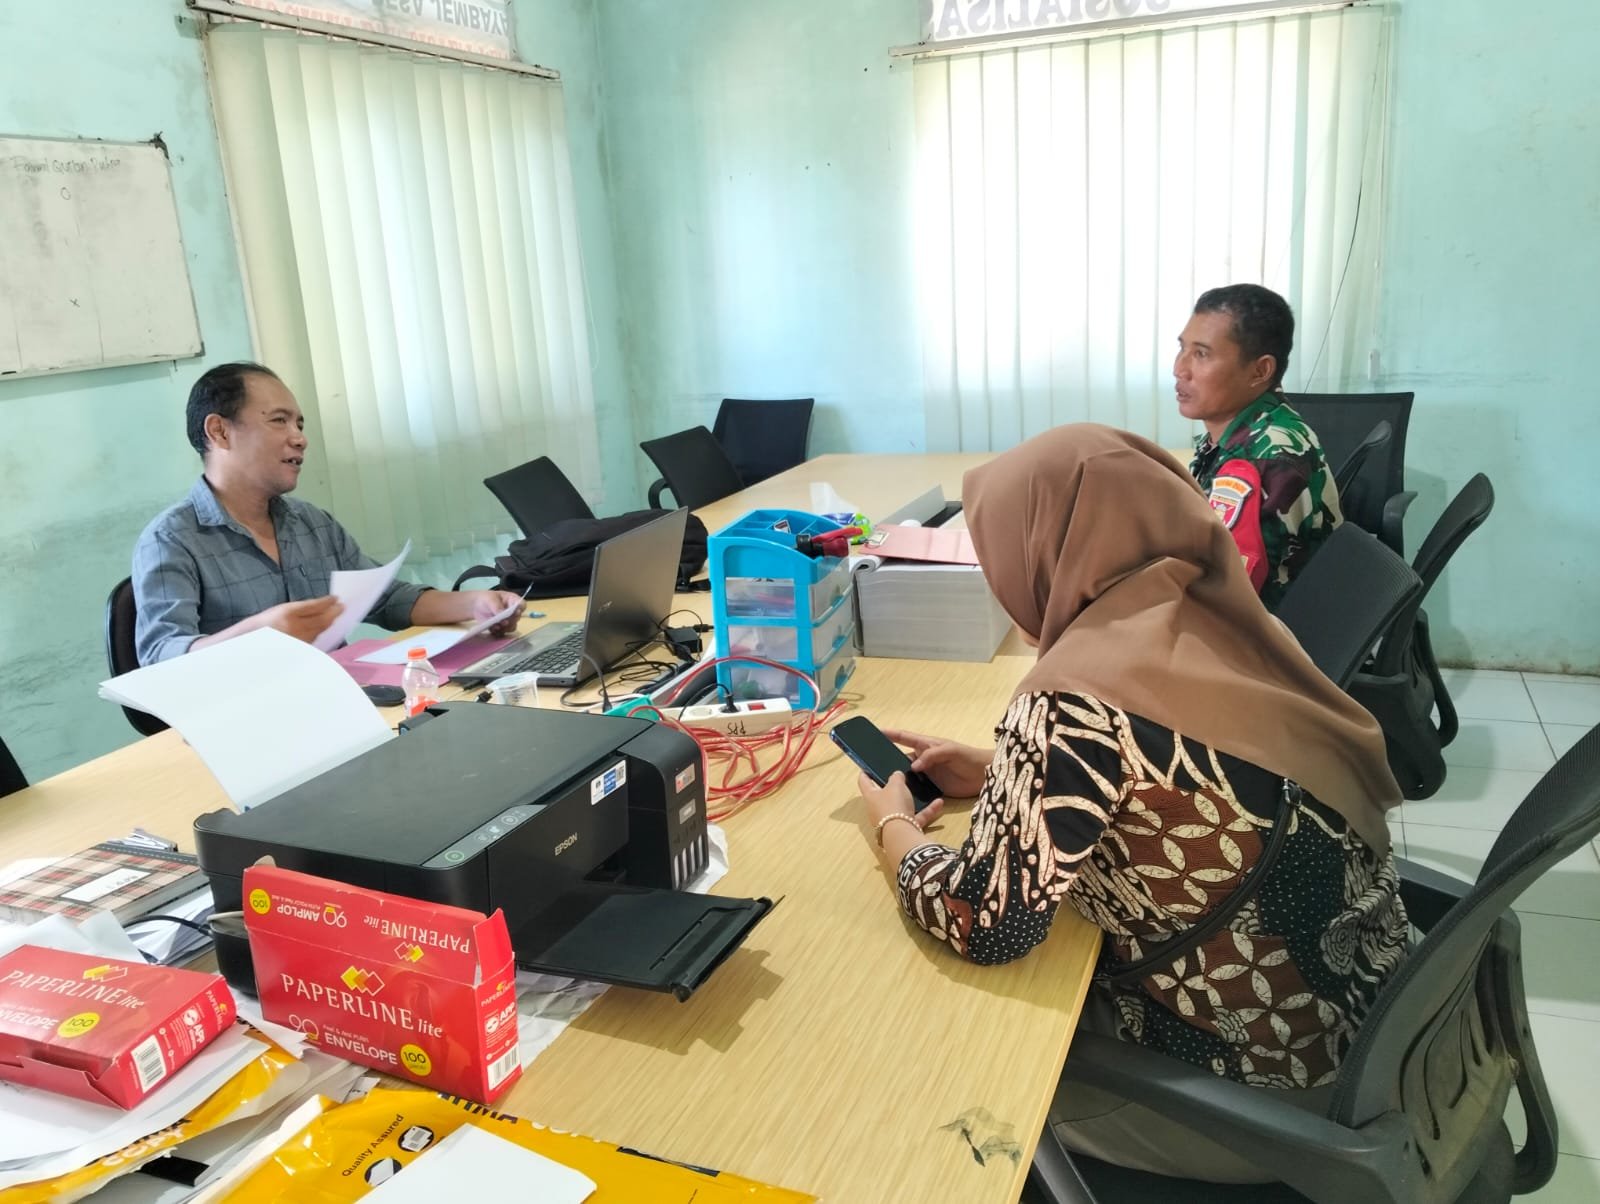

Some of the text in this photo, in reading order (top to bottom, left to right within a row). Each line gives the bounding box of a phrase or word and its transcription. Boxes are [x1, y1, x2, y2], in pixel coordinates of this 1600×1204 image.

[555, 832, 578, 856] EPSON
[251, 898, 269, 909] 100
[276, 903, 348, 929] 90 AMPLOP
[363, 914, 471, 954] PAPERLINE lite
[0, 970, 146, 1010] PAPERLINE lite
[280, 973, 415, 1031] PAPERLINE
[417, 1018, 443, 1038] lite
[68, 1018, 95, 1029] 100
[324, 1032, 398, 1065] ENVELOPE
[402, 1051, 427, 1065] 100
[342, 1113, 404, 1177] Quality Assured
